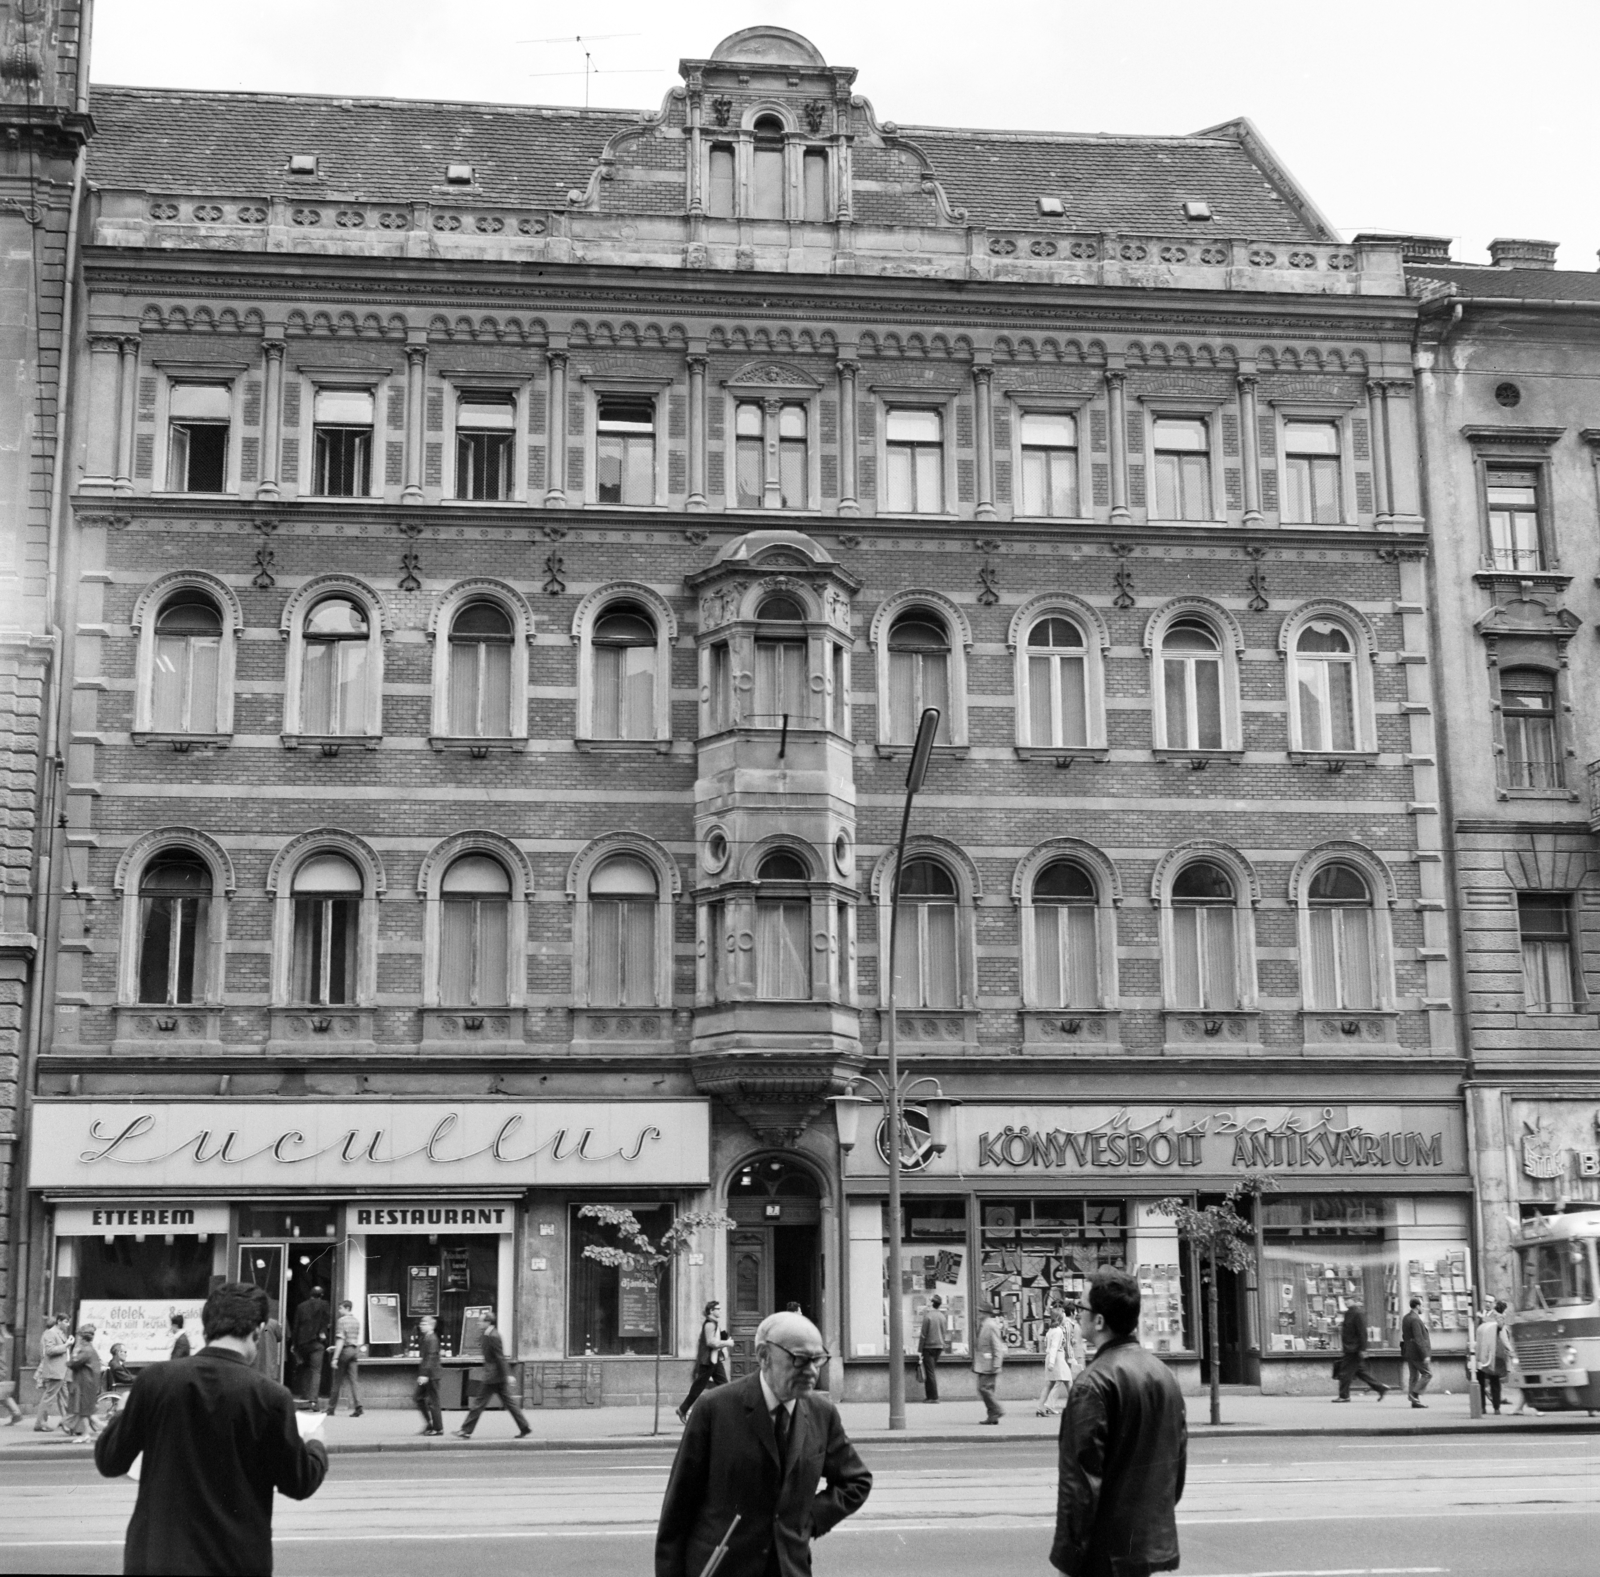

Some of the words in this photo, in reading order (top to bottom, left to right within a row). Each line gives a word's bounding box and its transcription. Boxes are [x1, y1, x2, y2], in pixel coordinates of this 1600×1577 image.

[1055, 1107, 1361, 1134] Műszaki
[78, 1112, 661, 1164] Lucullus
[979, 1126, 1206, 1168] KÖNYVESBOLT
[1231, 1127, 1443, 1168] ANTIKVÁRIUM
[92, 1207, 194, 1225] ÉTTEREM
[357, 1208, 505, 1225] RESTAURANT
[110, 1305, 145, 1320] ételek
